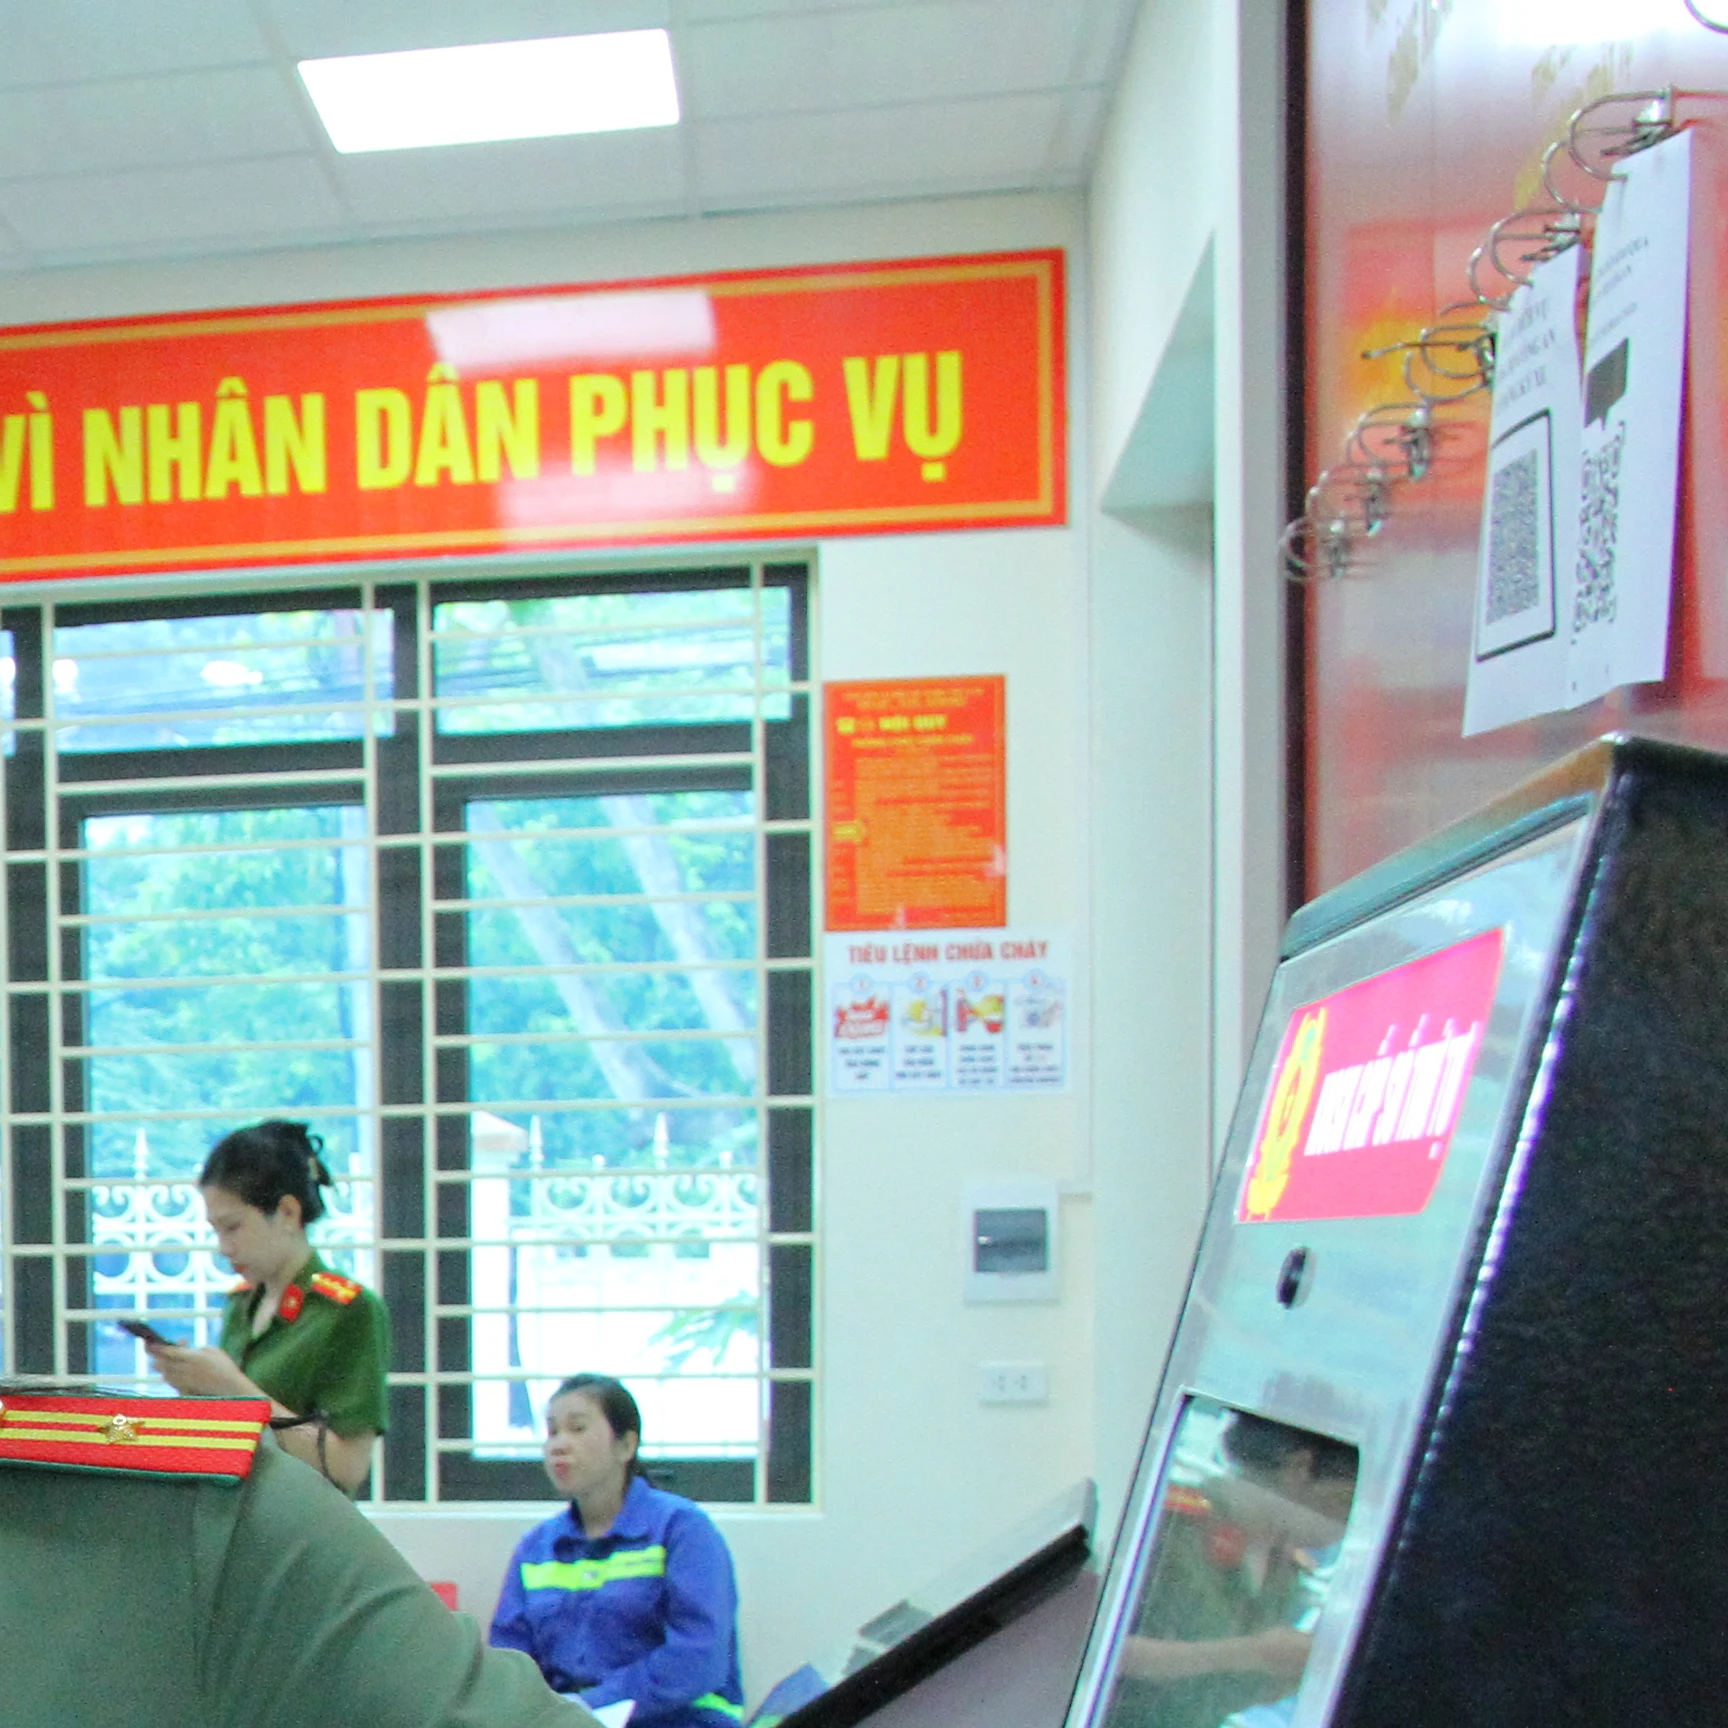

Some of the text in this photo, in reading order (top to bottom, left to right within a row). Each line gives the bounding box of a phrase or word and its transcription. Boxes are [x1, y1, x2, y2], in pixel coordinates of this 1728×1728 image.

[83, 376, 328, 508] NHÂN
[355, 363, 542, 492] DÂN
[568, 358, 815, 492] PHỤC
[842, 350, 965, 483] VỤ
[848, 937, 1049, 964] TIÊU LỆNH CHỮA CHÁY
